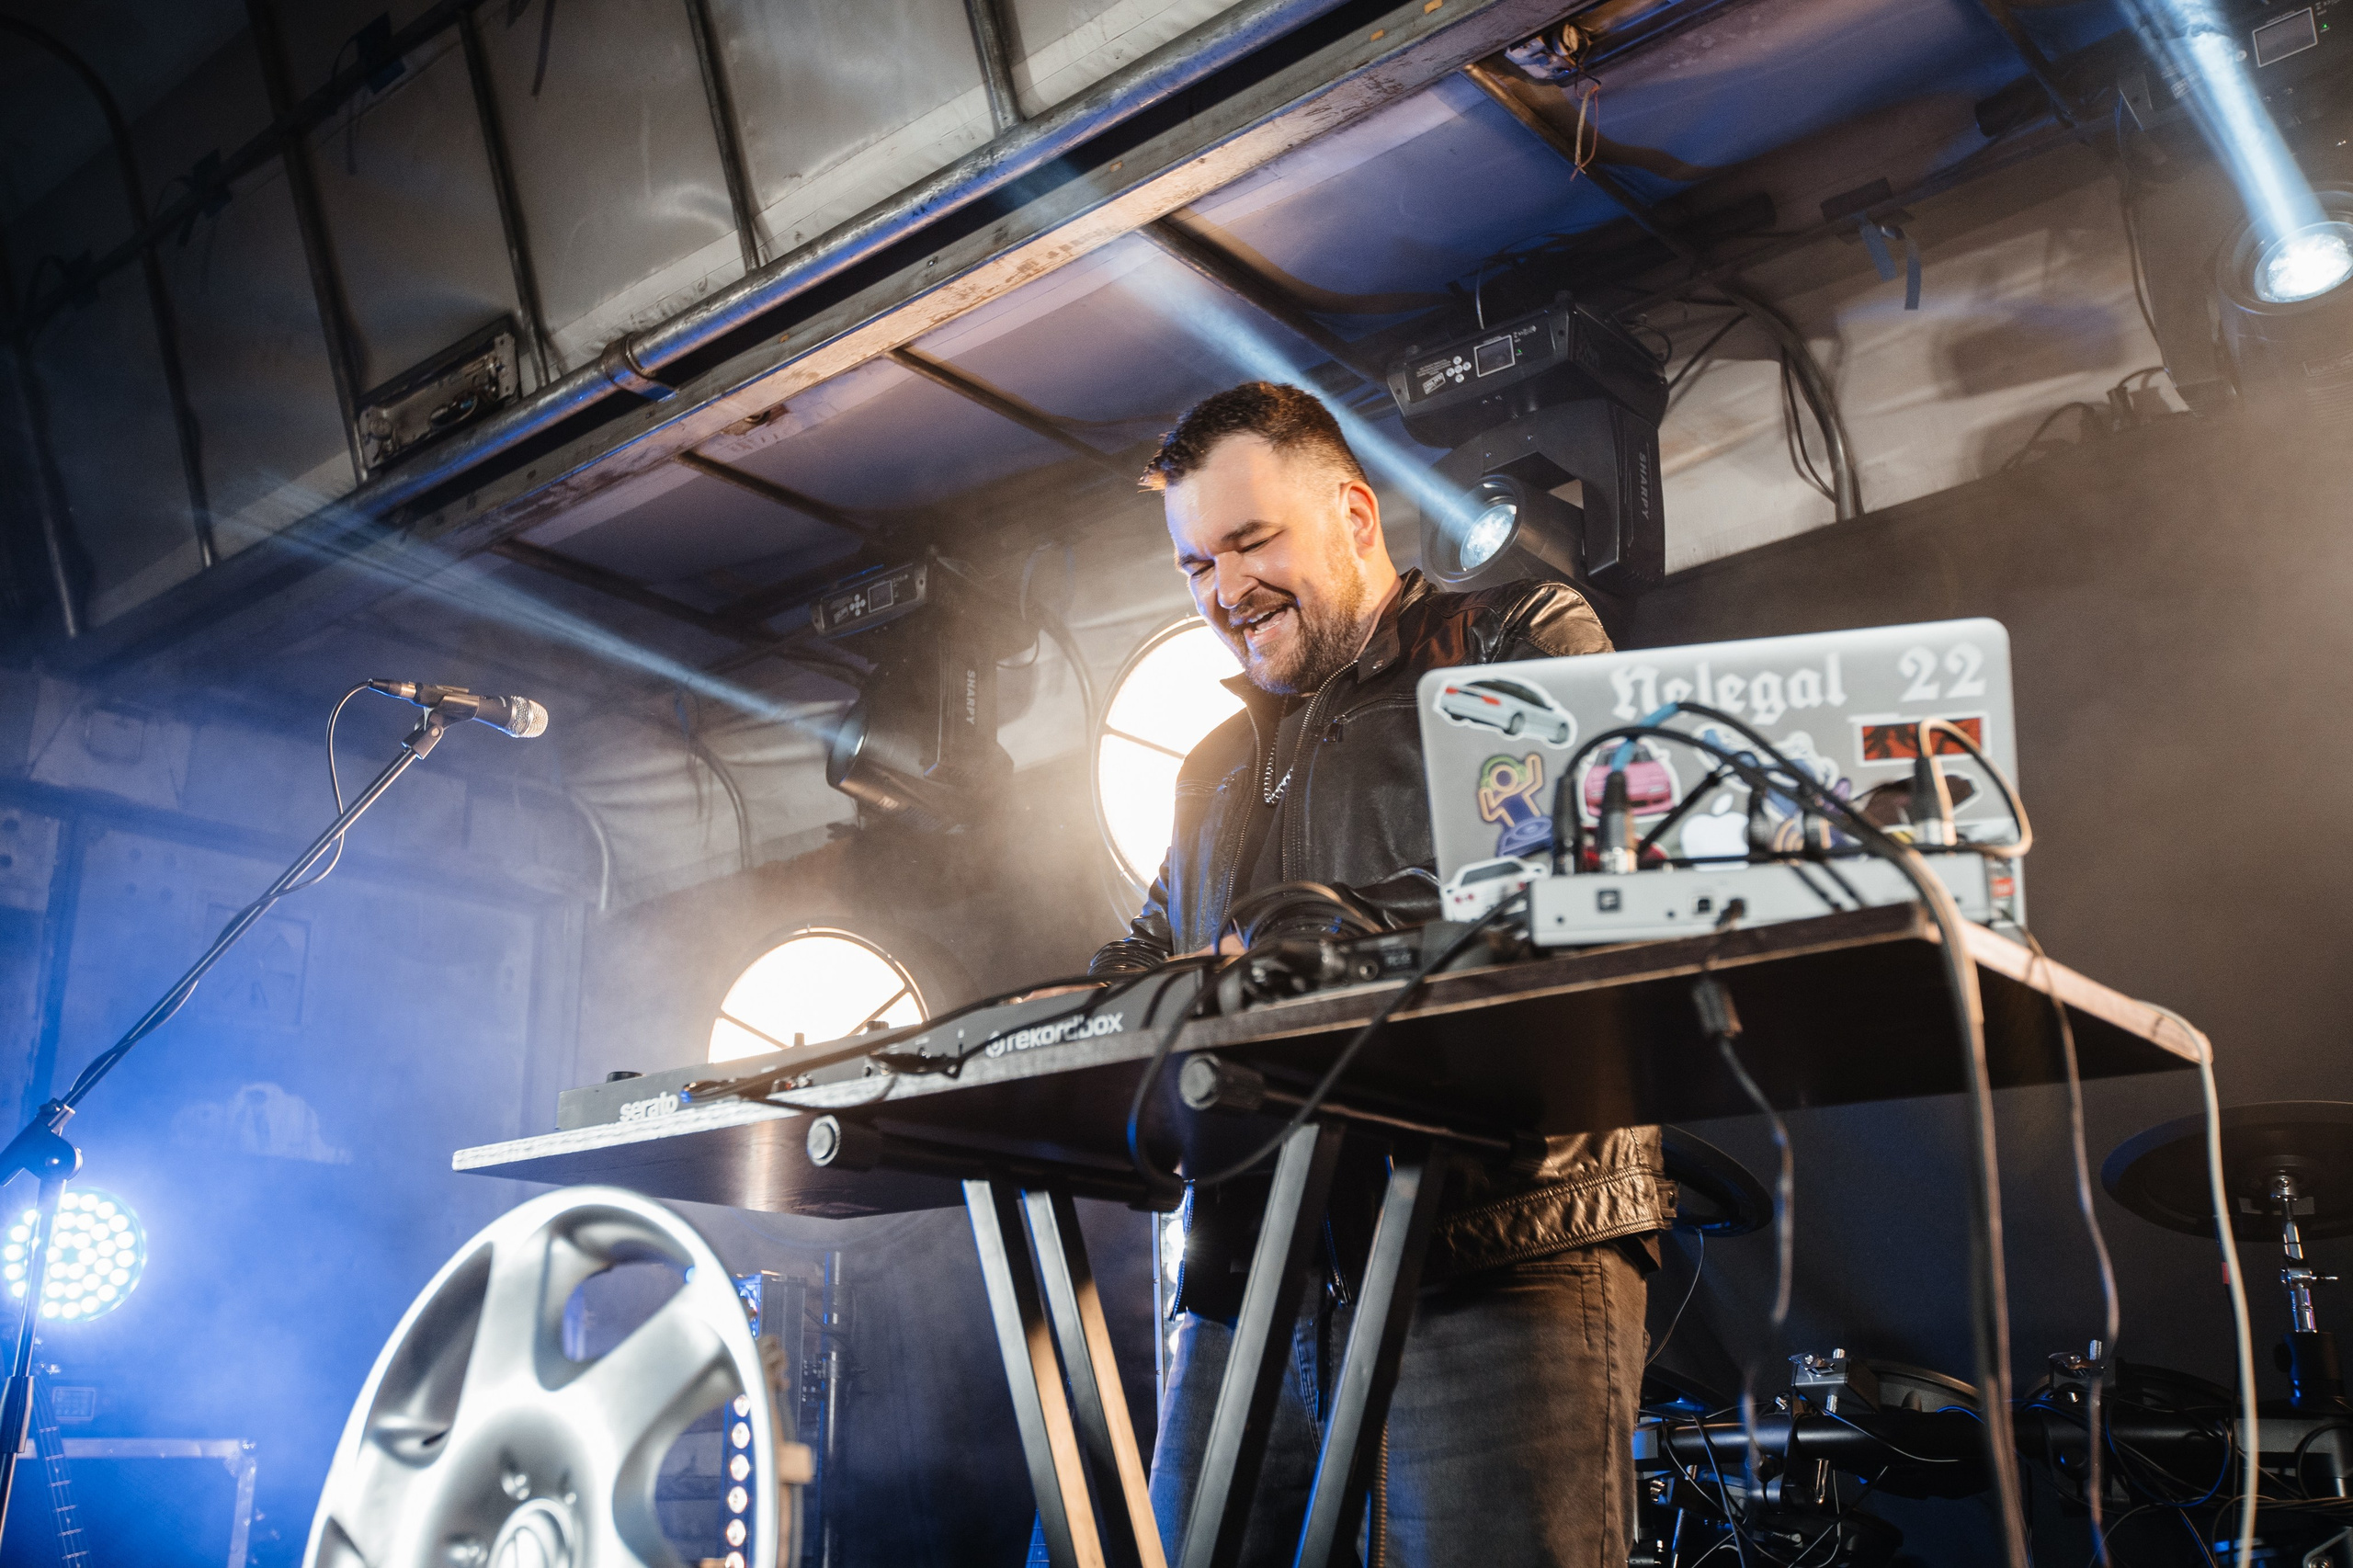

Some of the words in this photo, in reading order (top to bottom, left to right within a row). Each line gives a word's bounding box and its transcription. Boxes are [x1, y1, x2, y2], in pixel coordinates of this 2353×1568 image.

[1639, 451, 1650, 521] SHARPY
[966, 669, 976, 726] SHARPY
[1896, 642, 1986, 703] 22
[619, 1091, 679, 1121] serato
